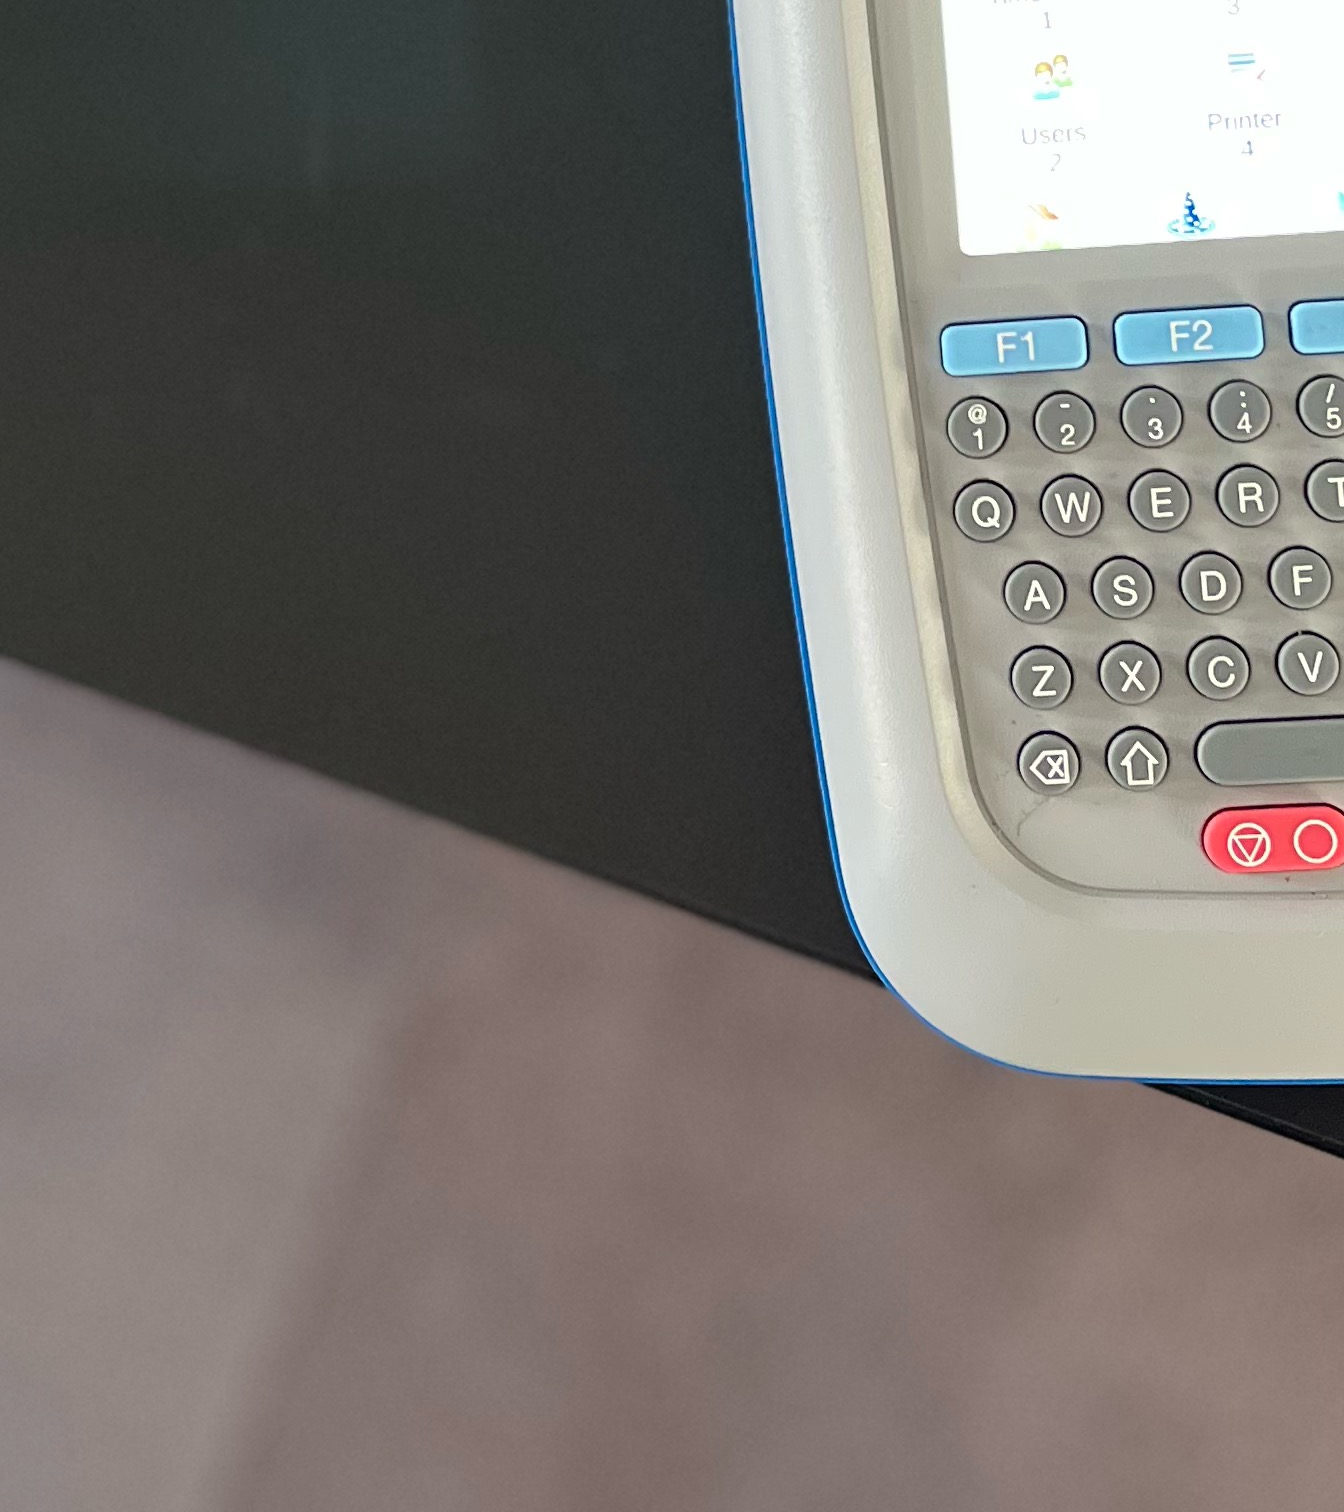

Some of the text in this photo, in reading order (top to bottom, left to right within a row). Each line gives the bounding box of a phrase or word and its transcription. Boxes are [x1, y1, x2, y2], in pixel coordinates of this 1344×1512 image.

[1021, 124, 1087, 146] Users
[1207, 111, 1283, 132] Printer
[997, 331, 1035, 363] F1
[1169, 319, 1214, 352] F2
[1059, 423, 1076, 446] 2
[1147, 417, 1164, 440] 3
[1236, 411, 1253, 434] 4
[1326, 407, 1343, 430] 5
[971, 428, 984, 450] 1
[971, 495, 1001, 528] Q
[1054, 491, 1091, 524] W
[1150, 486, 1175, 518] E
[1237, 482, 1265, 514] R
[1024, 579, 1051, 611] A
[1113, 574, 1138, 607] S
[1200, 570, 1227, 601] D
[1291, 565, 1314, 596] F
[1031, 665, 1057, 697] Z
[1119, 660, 1146, 692] X
[1207, 655, 1236, 688] C
[1297, 651, 1323, 683] V
